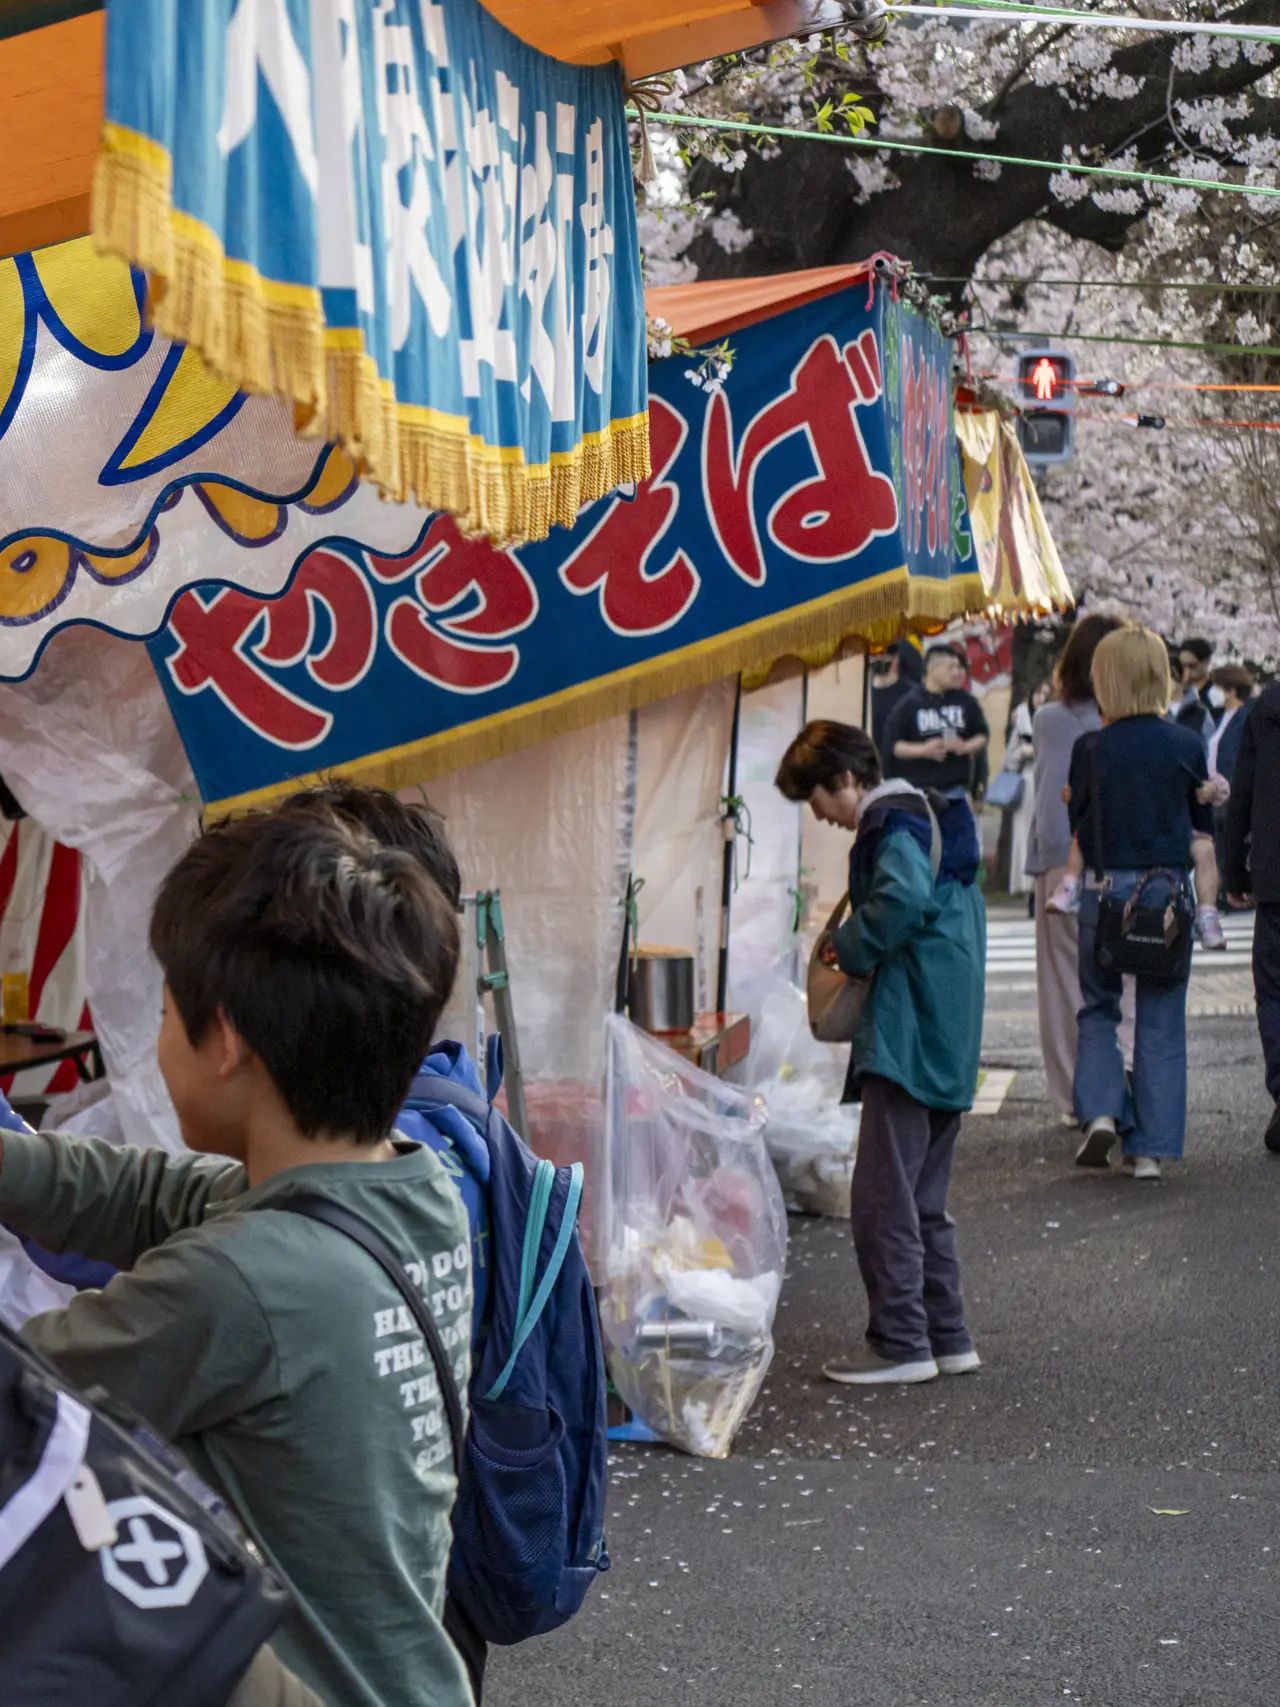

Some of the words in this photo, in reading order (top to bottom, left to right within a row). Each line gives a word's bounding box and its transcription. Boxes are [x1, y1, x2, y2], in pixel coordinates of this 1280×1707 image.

[166, 328, 900, 751] やきそば
[374, 1339, 426, 1377] THE
